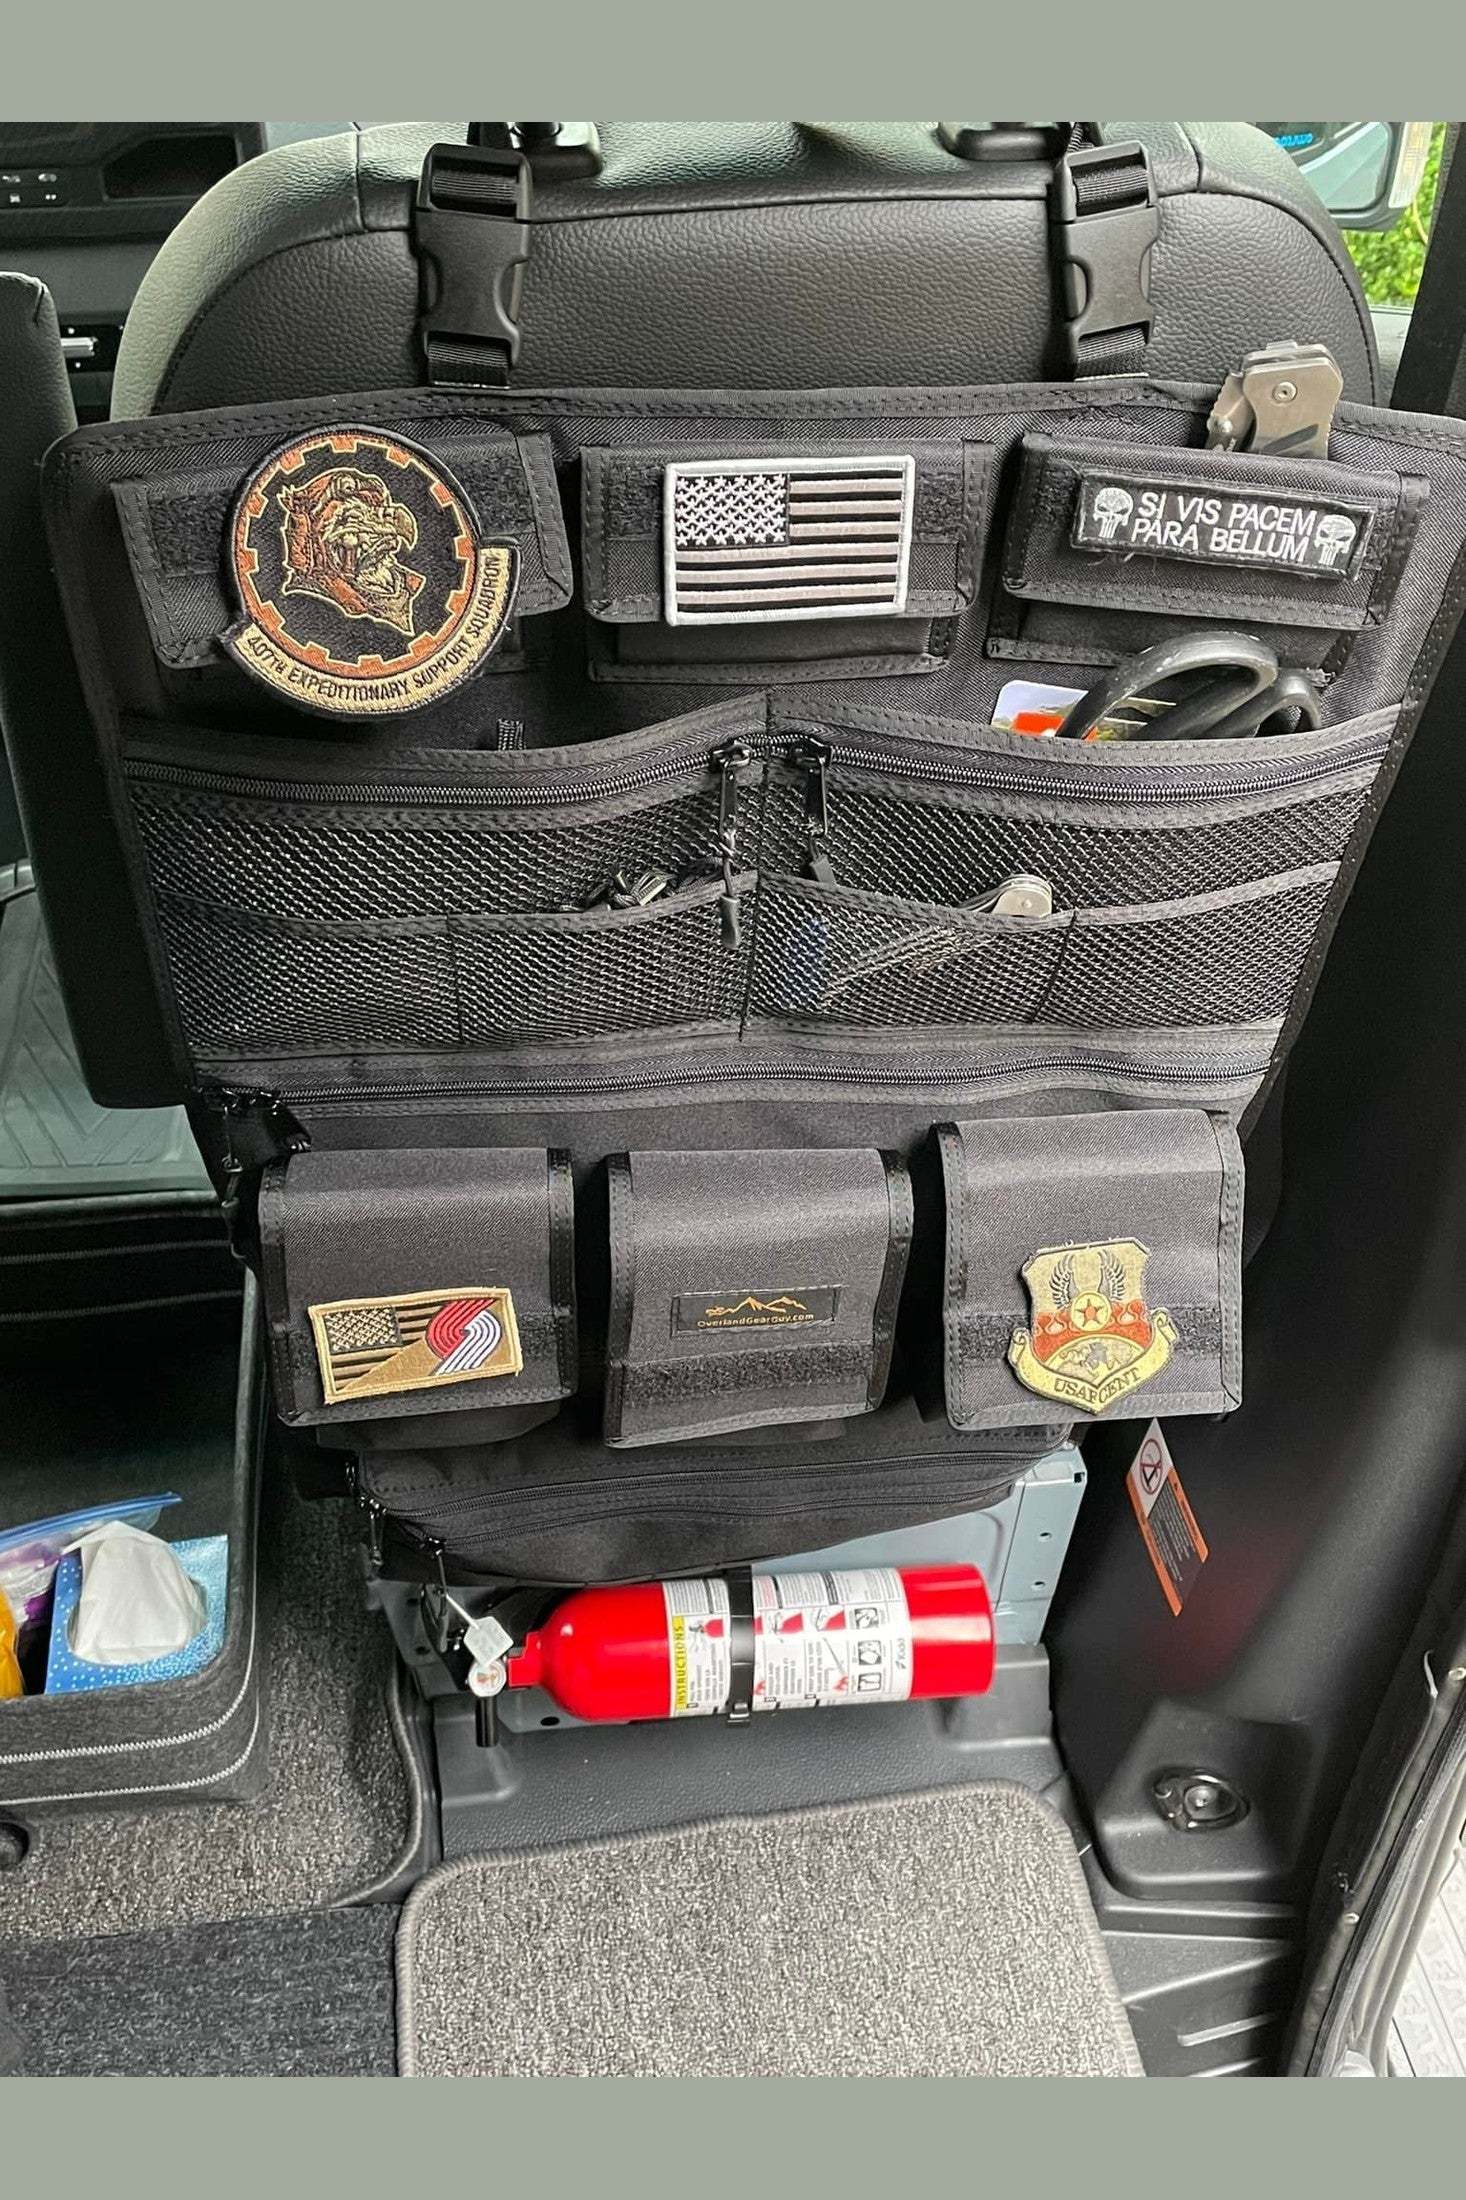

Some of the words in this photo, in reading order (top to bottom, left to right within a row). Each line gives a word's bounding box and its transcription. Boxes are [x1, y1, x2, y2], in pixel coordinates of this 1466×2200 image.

[1137, 491, 1167, 520] SI
[1177, 494, 1223, 526] VIS
[1227, 502, 1318, 537] PACEM
[1130, 518, 1199, 550] PARA
[1209, 527, 1311, 563] BELLUM
[287, 668, 409, 702] EXPEDITIONARY
[412, 636, 473, 689] SUPPORT
[465, 556, 503, 642] SQUADRON
[697, 1313, 814, 1328] OverlandGearGuy.com
[673, 1624, 688, 1705] INSTRUCTIONS
